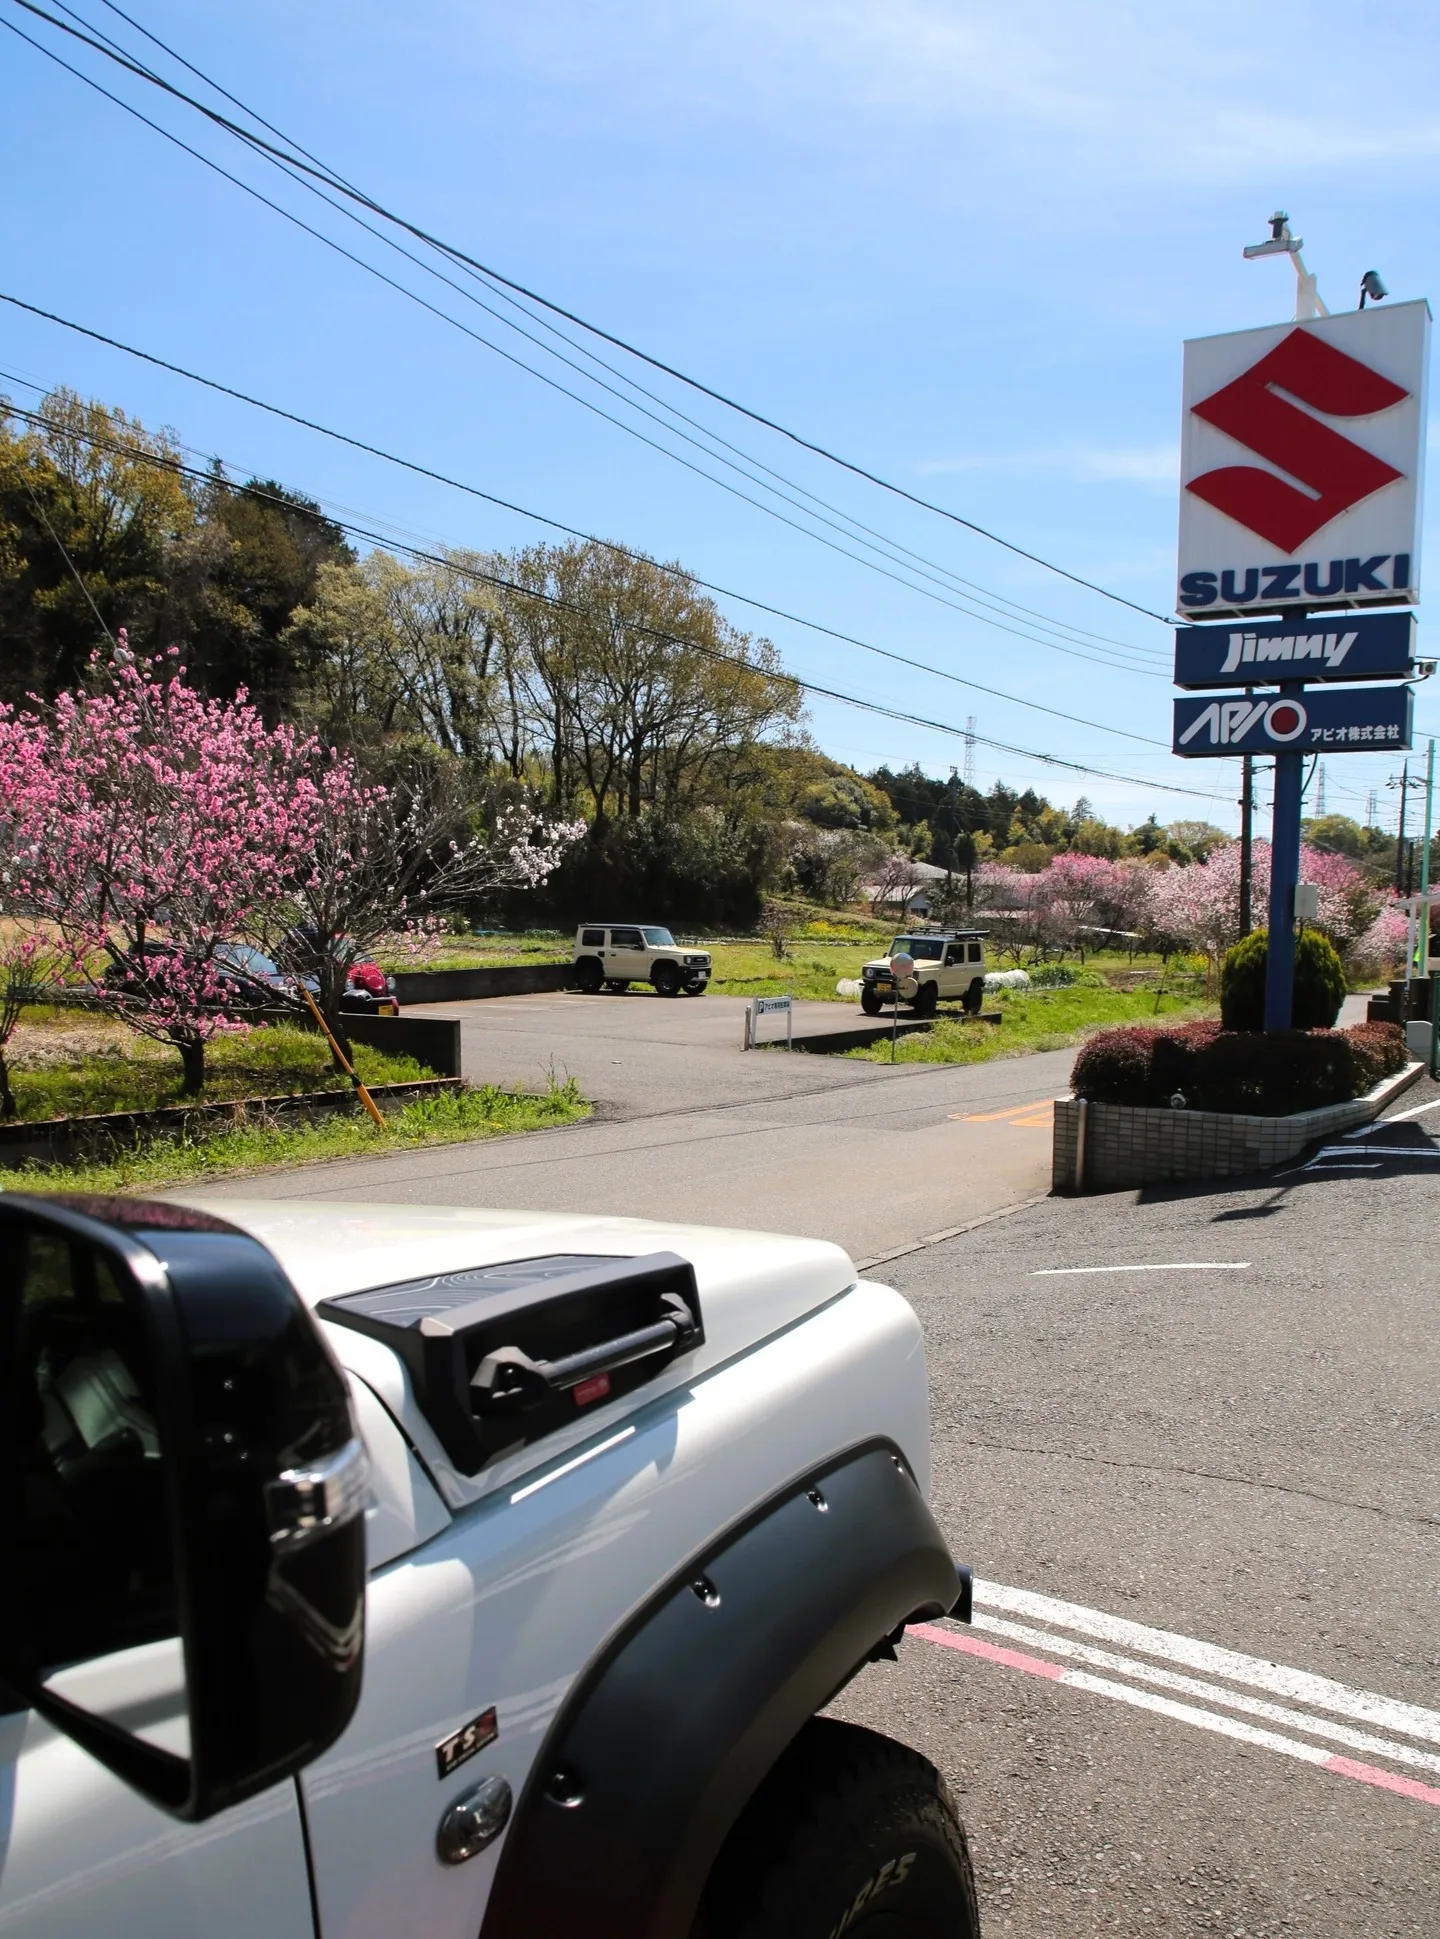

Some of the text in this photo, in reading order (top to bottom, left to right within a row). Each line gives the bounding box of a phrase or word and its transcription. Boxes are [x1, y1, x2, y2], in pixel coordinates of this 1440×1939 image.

[1180, 554, 1410, 607] SUZUKI
[1219, 631, 1359, 673] Jimny
[1178, 699, 1307, 744] APIO
[1310, 723, 1400, 742] アピオ株式会社
